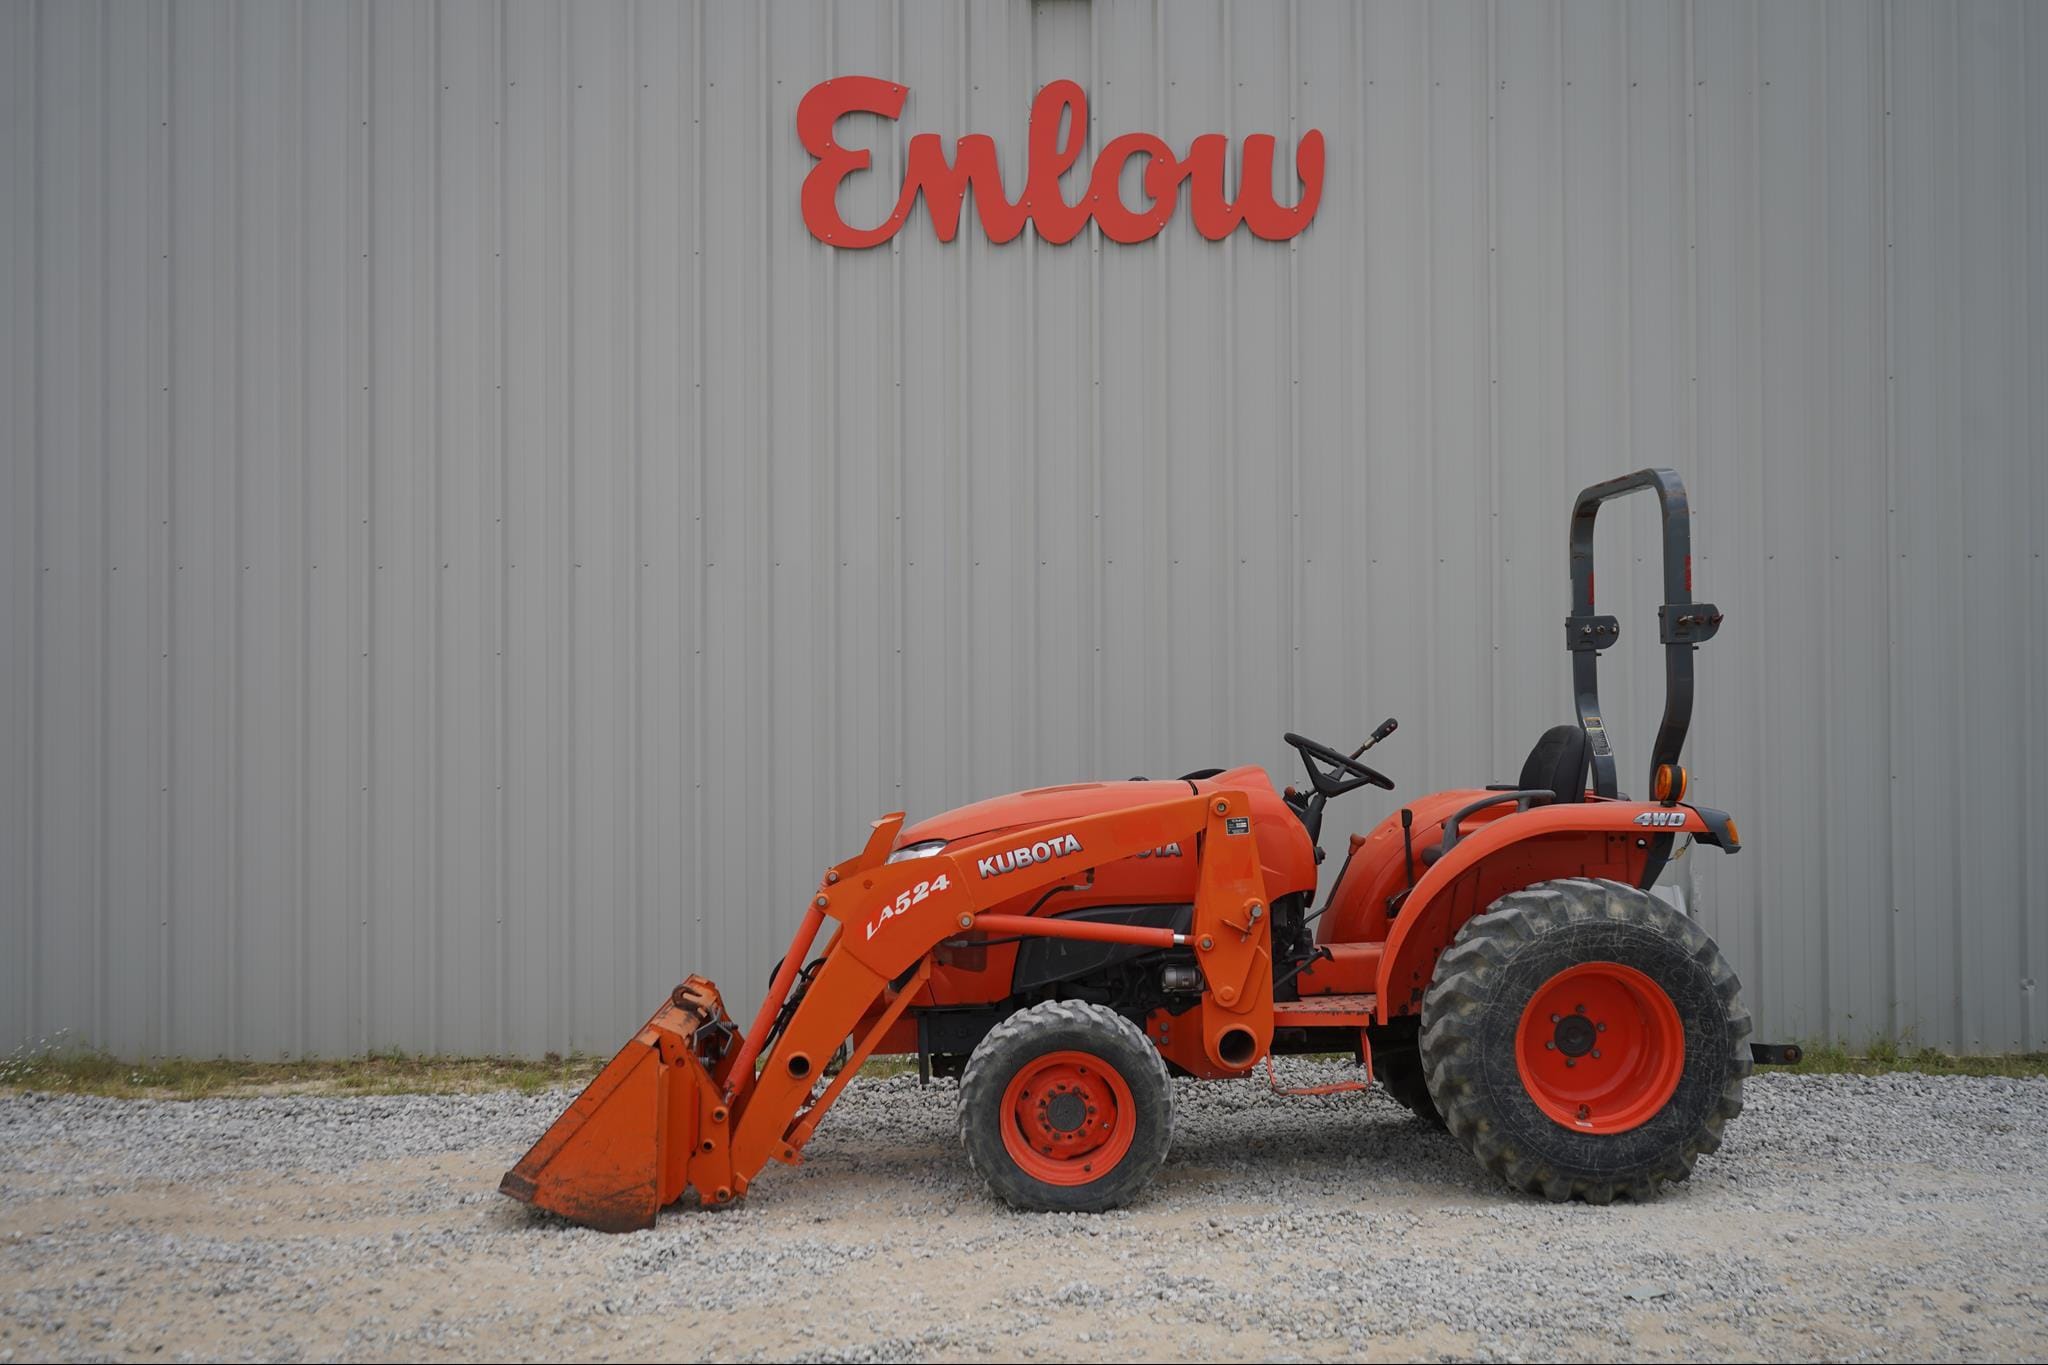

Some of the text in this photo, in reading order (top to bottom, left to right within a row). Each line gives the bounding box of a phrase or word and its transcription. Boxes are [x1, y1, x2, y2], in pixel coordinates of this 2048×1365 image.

[797, 76, 1325, 248] Enlow
[1635, 812, 1686, 827] 4WD
[978, 834, 1083, 879] KUBOTA
[866, 873, 950, 941] LA524
